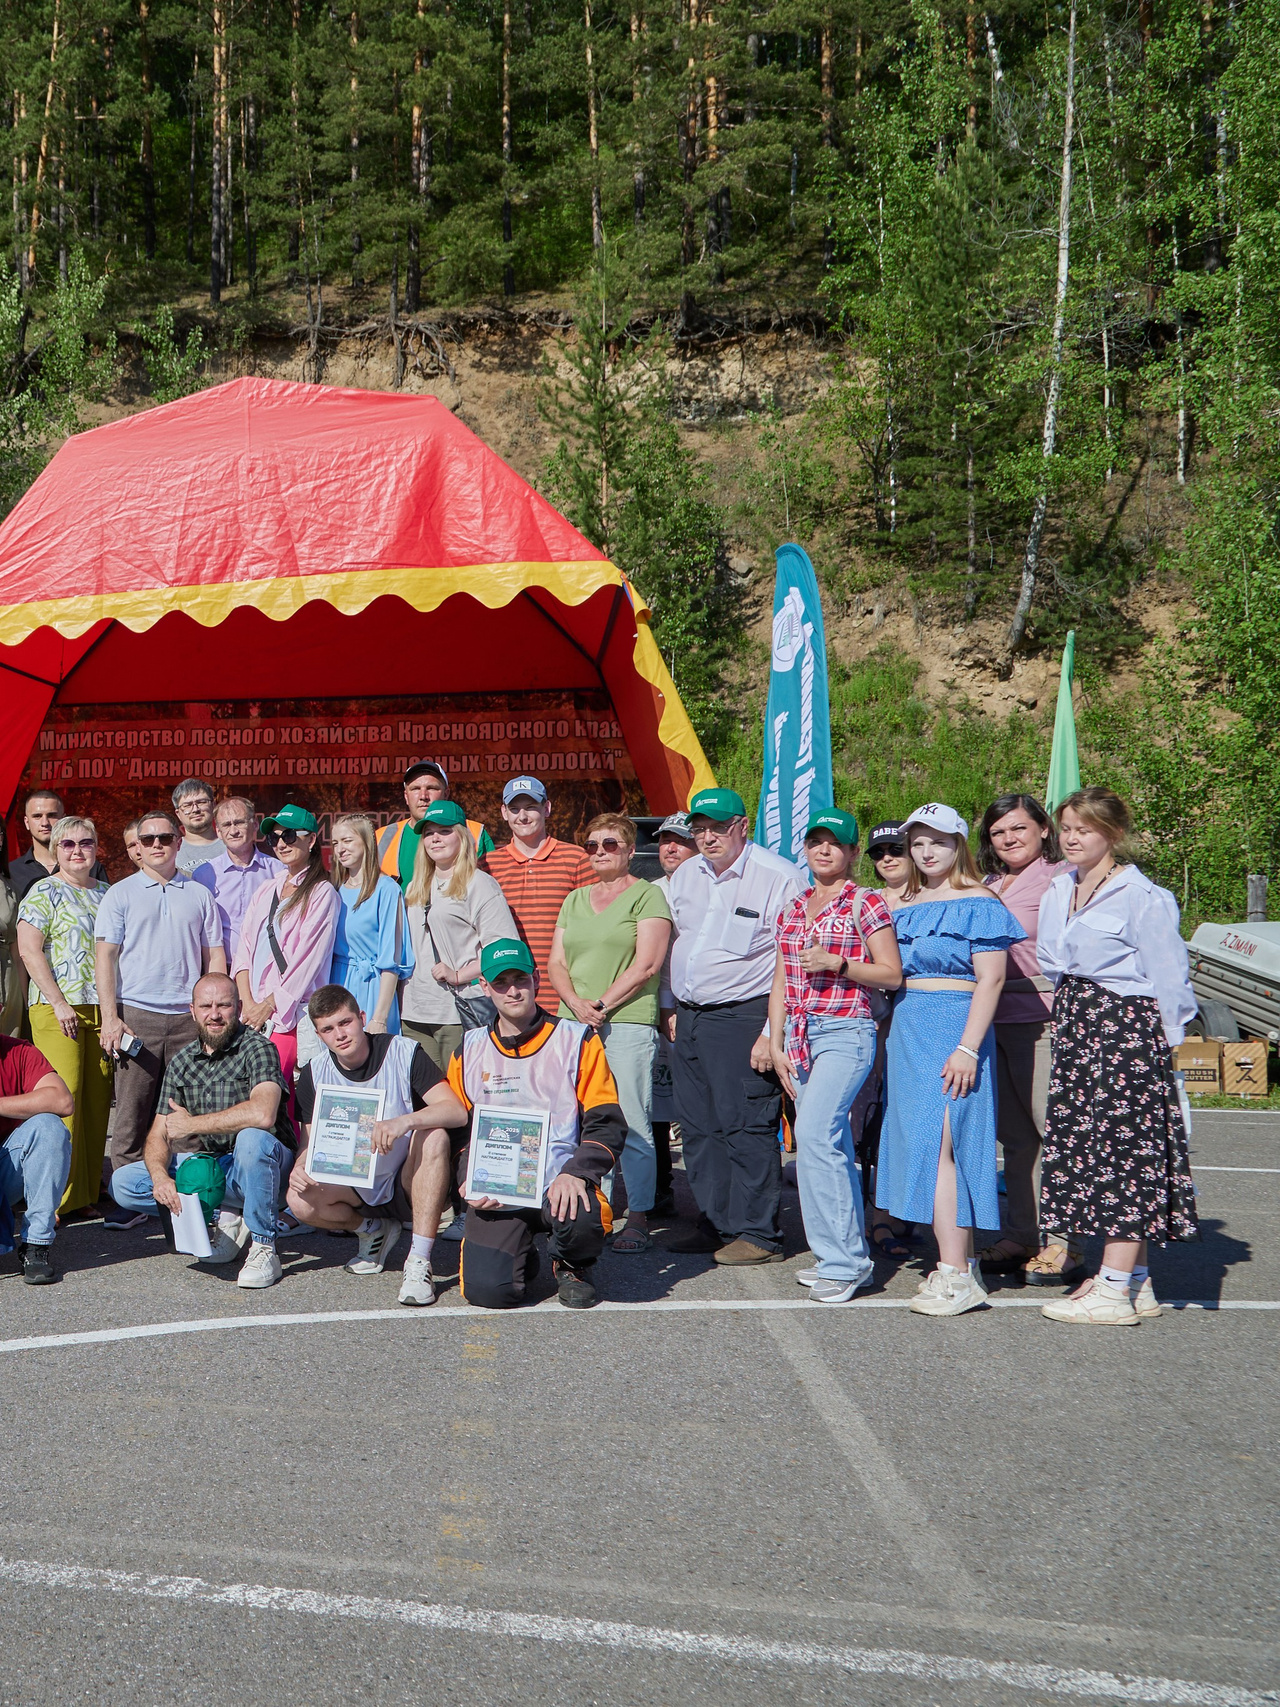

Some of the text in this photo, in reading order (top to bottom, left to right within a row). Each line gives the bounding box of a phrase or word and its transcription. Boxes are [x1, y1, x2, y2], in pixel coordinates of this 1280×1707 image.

[39, 729, 186, 751] Министерство
[189, 727, 276, 747] лесного
[279, 722, 393, 745] хозяйства
[397, 719, 570, 743] Красноярского
[41, 758, 74, 780] КГБ
[78, 758, 116, 779] ПОУ
[119, 754, 280, 780] "Дивногорский
[284, 756, 389, 776] техникум
[484, 749, 623, 772] технологий"
[873, 827, 898, 840] BABE
[1228, 934, 1258, 956] ZIMANI
